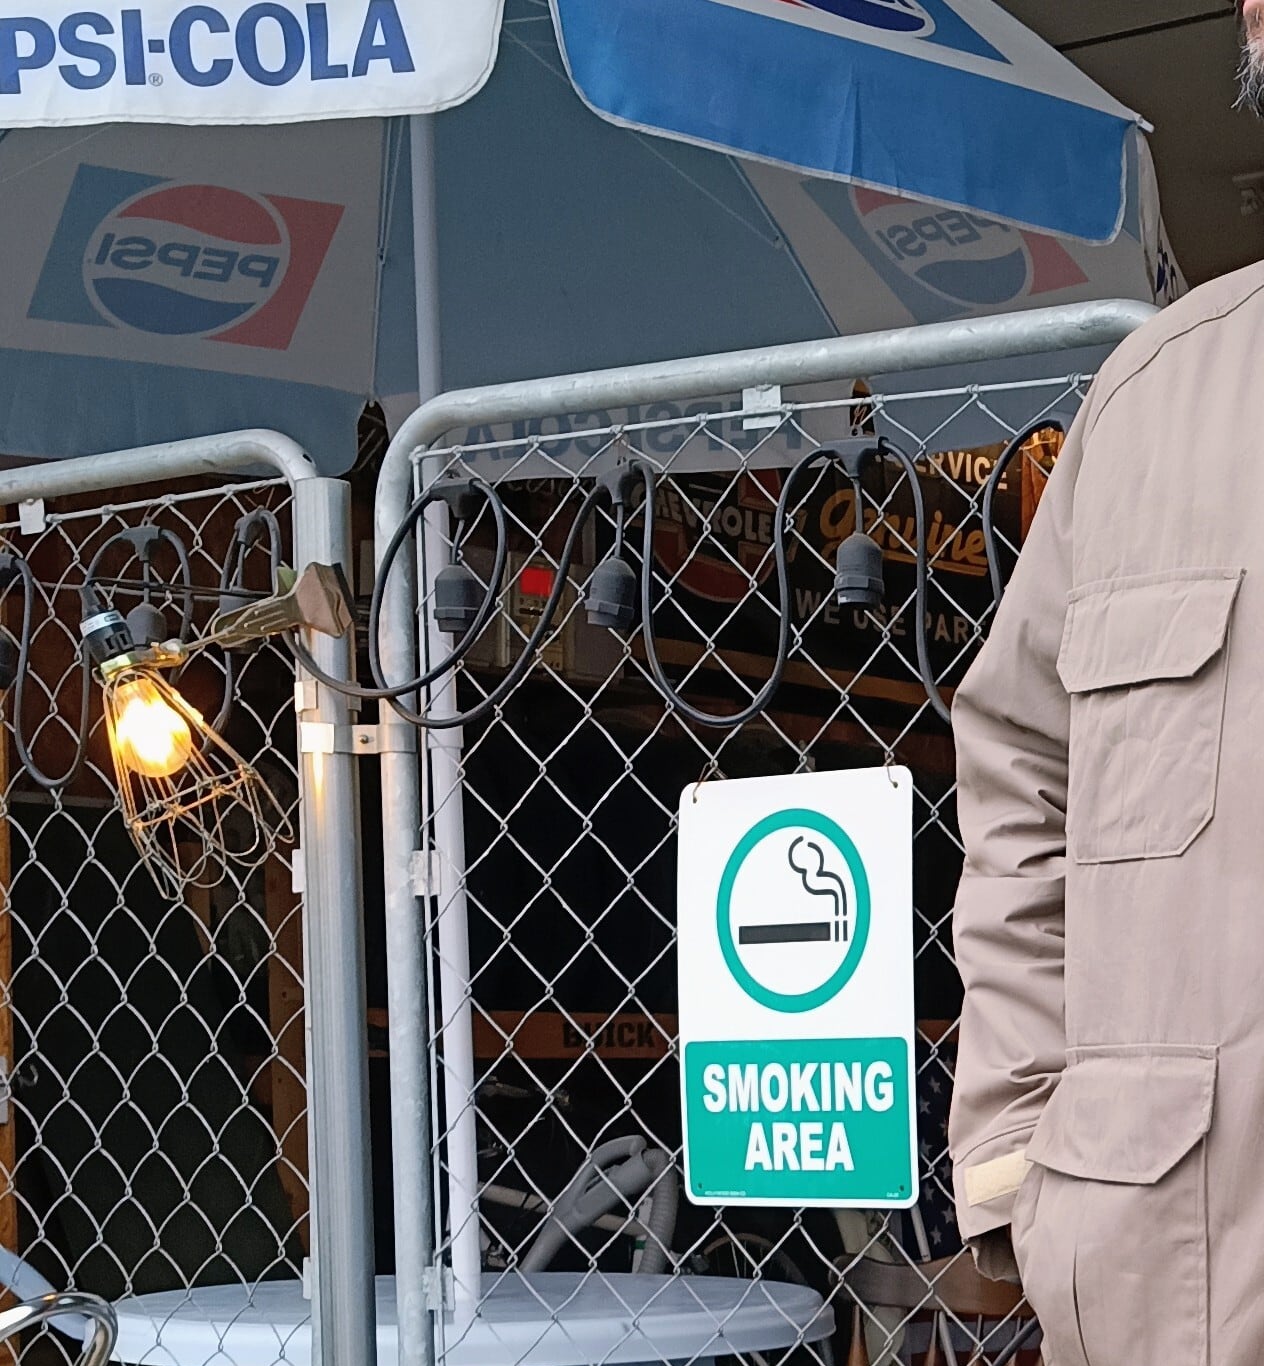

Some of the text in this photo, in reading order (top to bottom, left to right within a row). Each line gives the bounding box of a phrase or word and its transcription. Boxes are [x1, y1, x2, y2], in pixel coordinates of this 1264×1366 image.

[630, 482, 774, 544] CHEVROLE
[796, 587, 987, 645] WE USE PAR
[563, 1022, 655, 1049] BUICK
[703, 1060, 894, 1113] SMOKING
[744, 1122, 855, 1171] AREA
